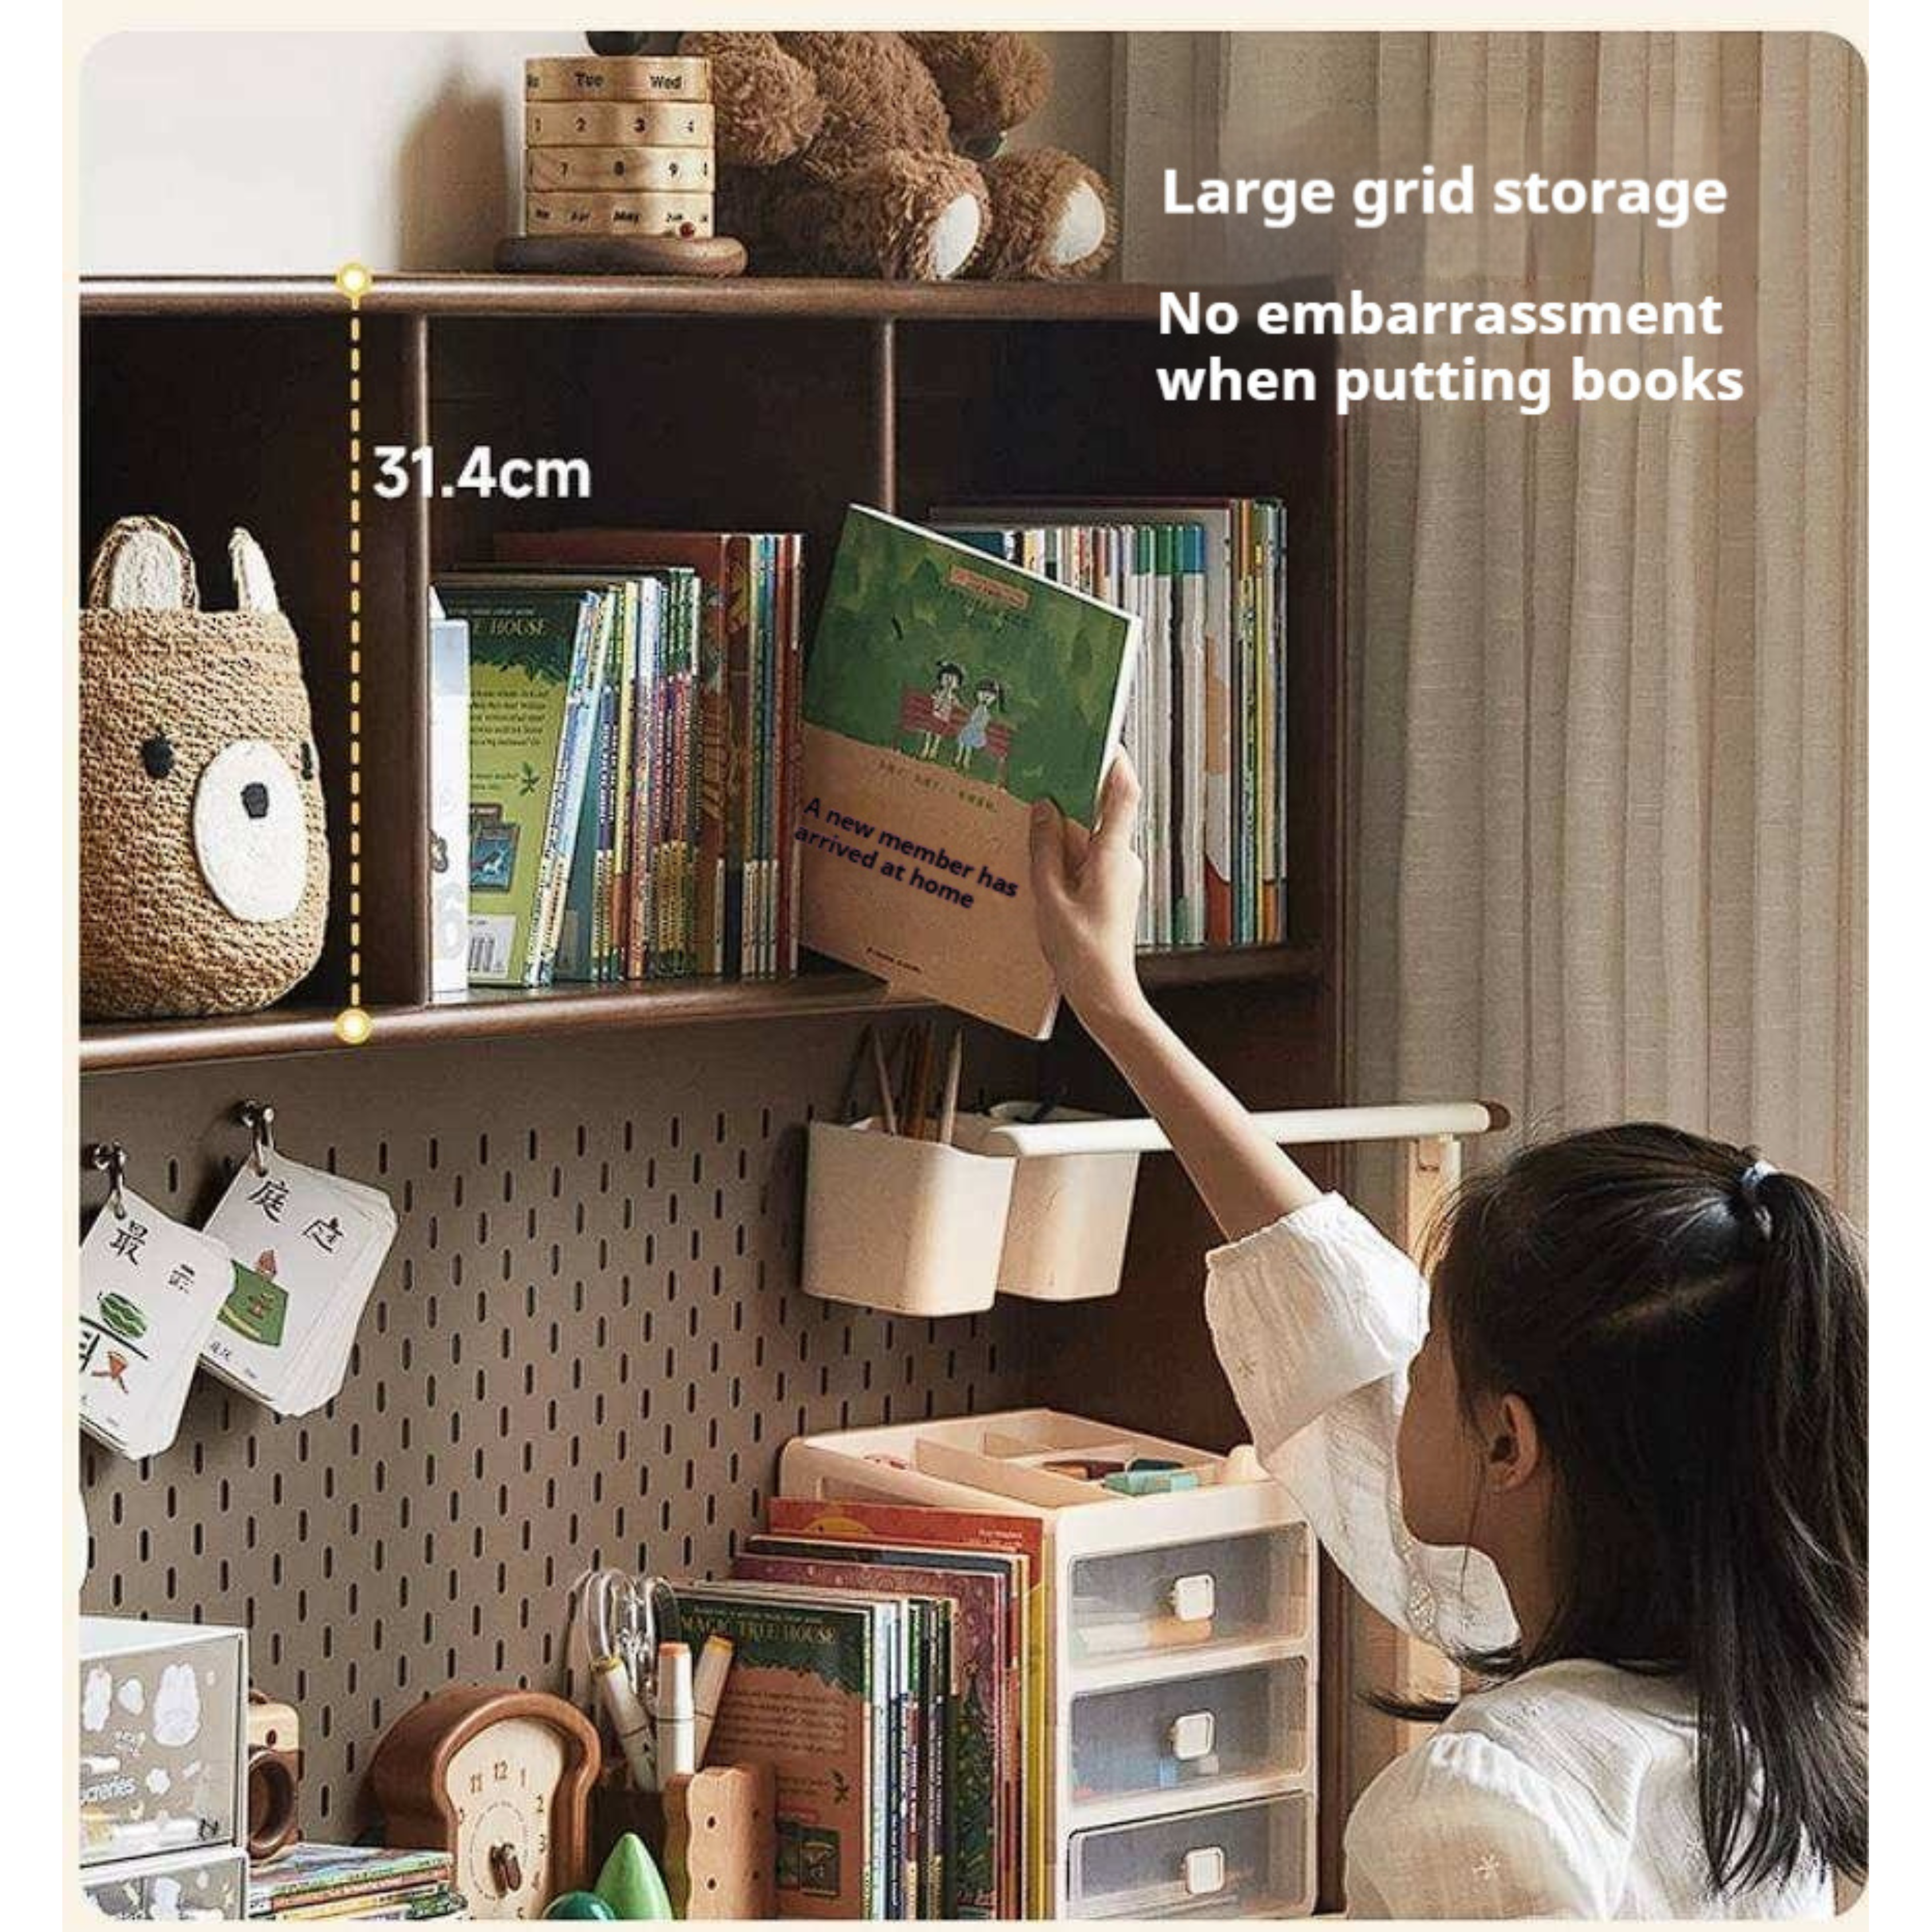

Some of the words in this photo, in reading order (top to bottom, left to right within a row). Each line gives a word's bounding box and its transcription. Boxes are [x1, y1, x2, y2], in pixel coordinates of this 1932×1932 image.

[650, 75, 682, 89] Wed
[575, 117, 587, 132] 2
[635, 118, 646, 132] 3
[248, 1180, 289, 1222] 庭
[109, 1219, 148, 1265] 最
[494, 1760, 508, 1780] 12
